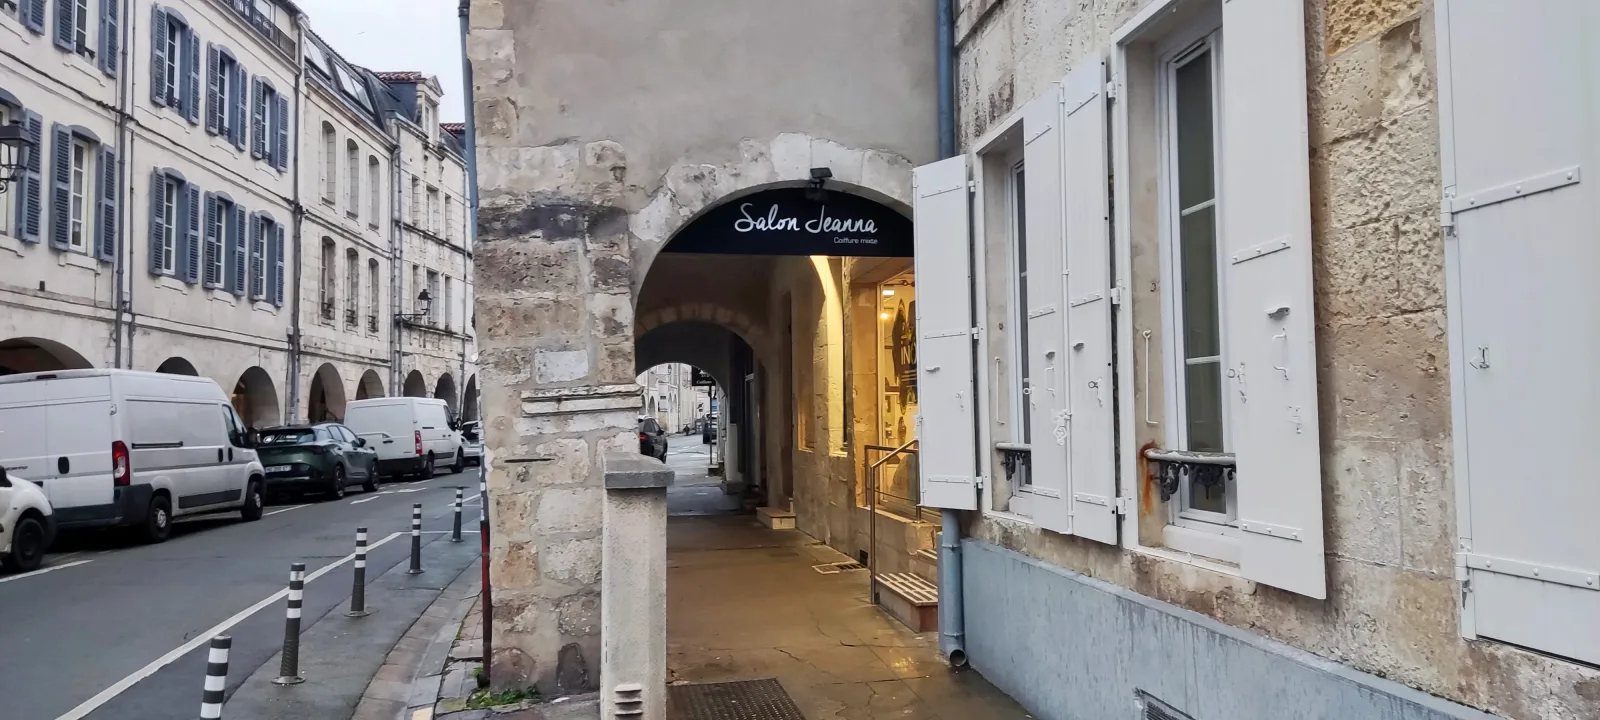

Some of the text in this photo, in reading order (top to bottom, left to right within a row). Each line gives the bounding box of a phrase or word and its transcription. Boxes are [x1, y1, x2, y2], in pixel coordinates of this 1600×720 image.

[734, 202, 878, 234] Salon Jeanna
[833, 236, 859, 244] Coiffure
